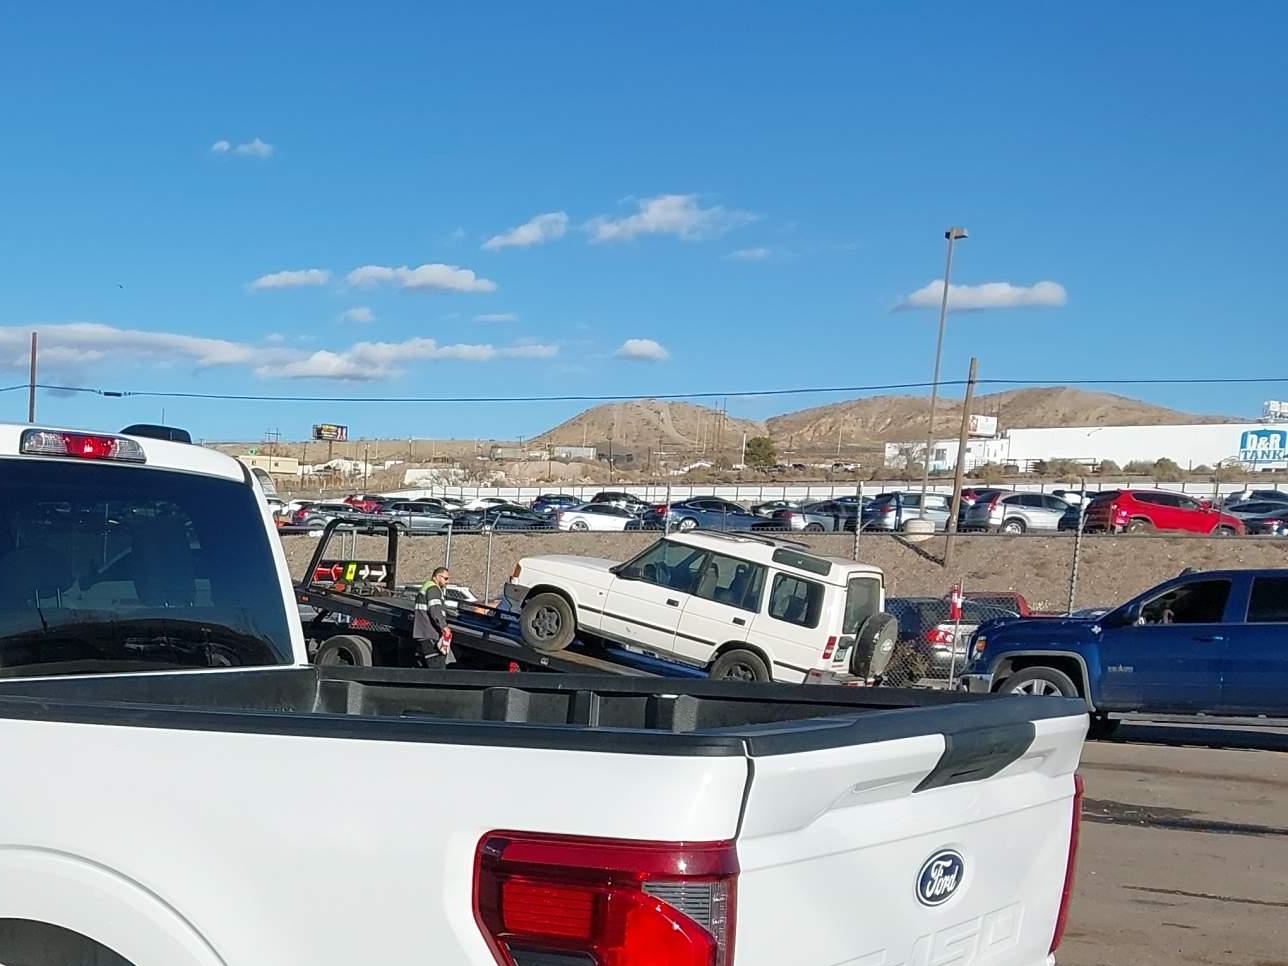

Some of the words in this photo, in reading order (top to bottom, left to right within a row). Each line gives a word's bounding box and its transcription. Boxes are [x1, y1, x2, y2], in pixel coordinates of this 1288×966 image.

[1246, 433, 1282, 450] D&R
[1241, 450, 1284, 460] TANK
[925, 859, 959, 898] Ford
